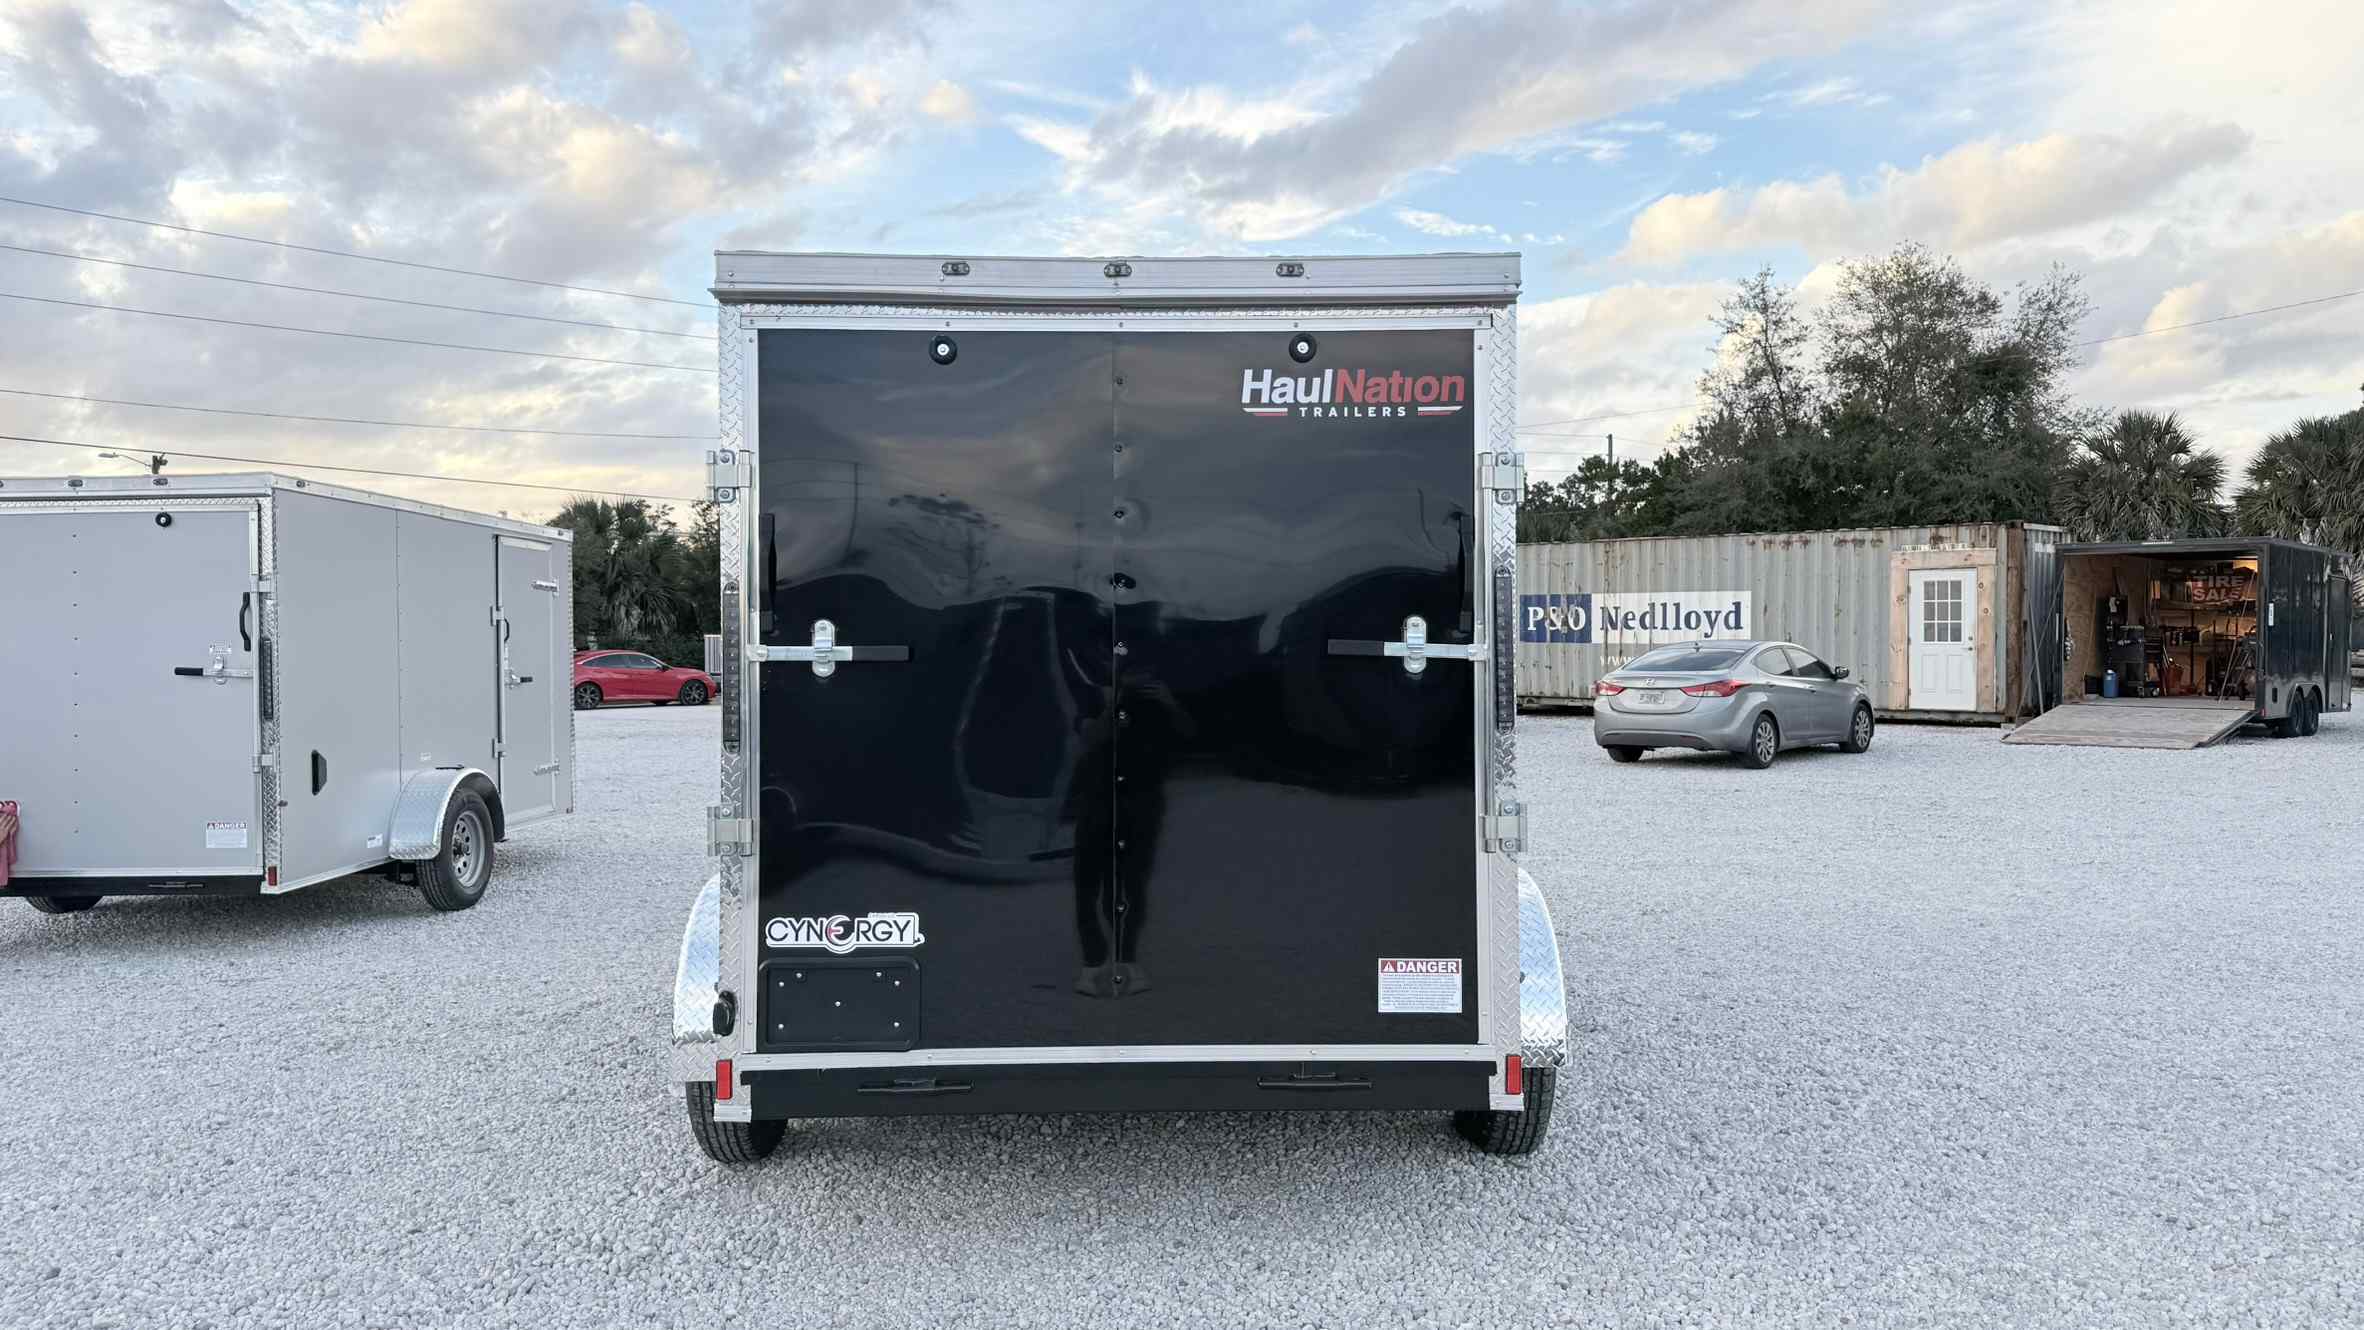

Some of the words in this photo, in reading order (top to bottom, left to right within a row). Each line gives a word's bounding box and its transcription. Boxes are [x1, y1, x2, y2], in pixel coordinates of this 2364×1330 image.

[1241, 368, 1465, 404] HaulNation
[1299, 406, 1407, 418] TRAILERS
[1600, 600, 1744, 639] Nedlloyd
[767, 917, 911, 943] CYNERGY
[1396, 961, 1457, 973] DANGER
